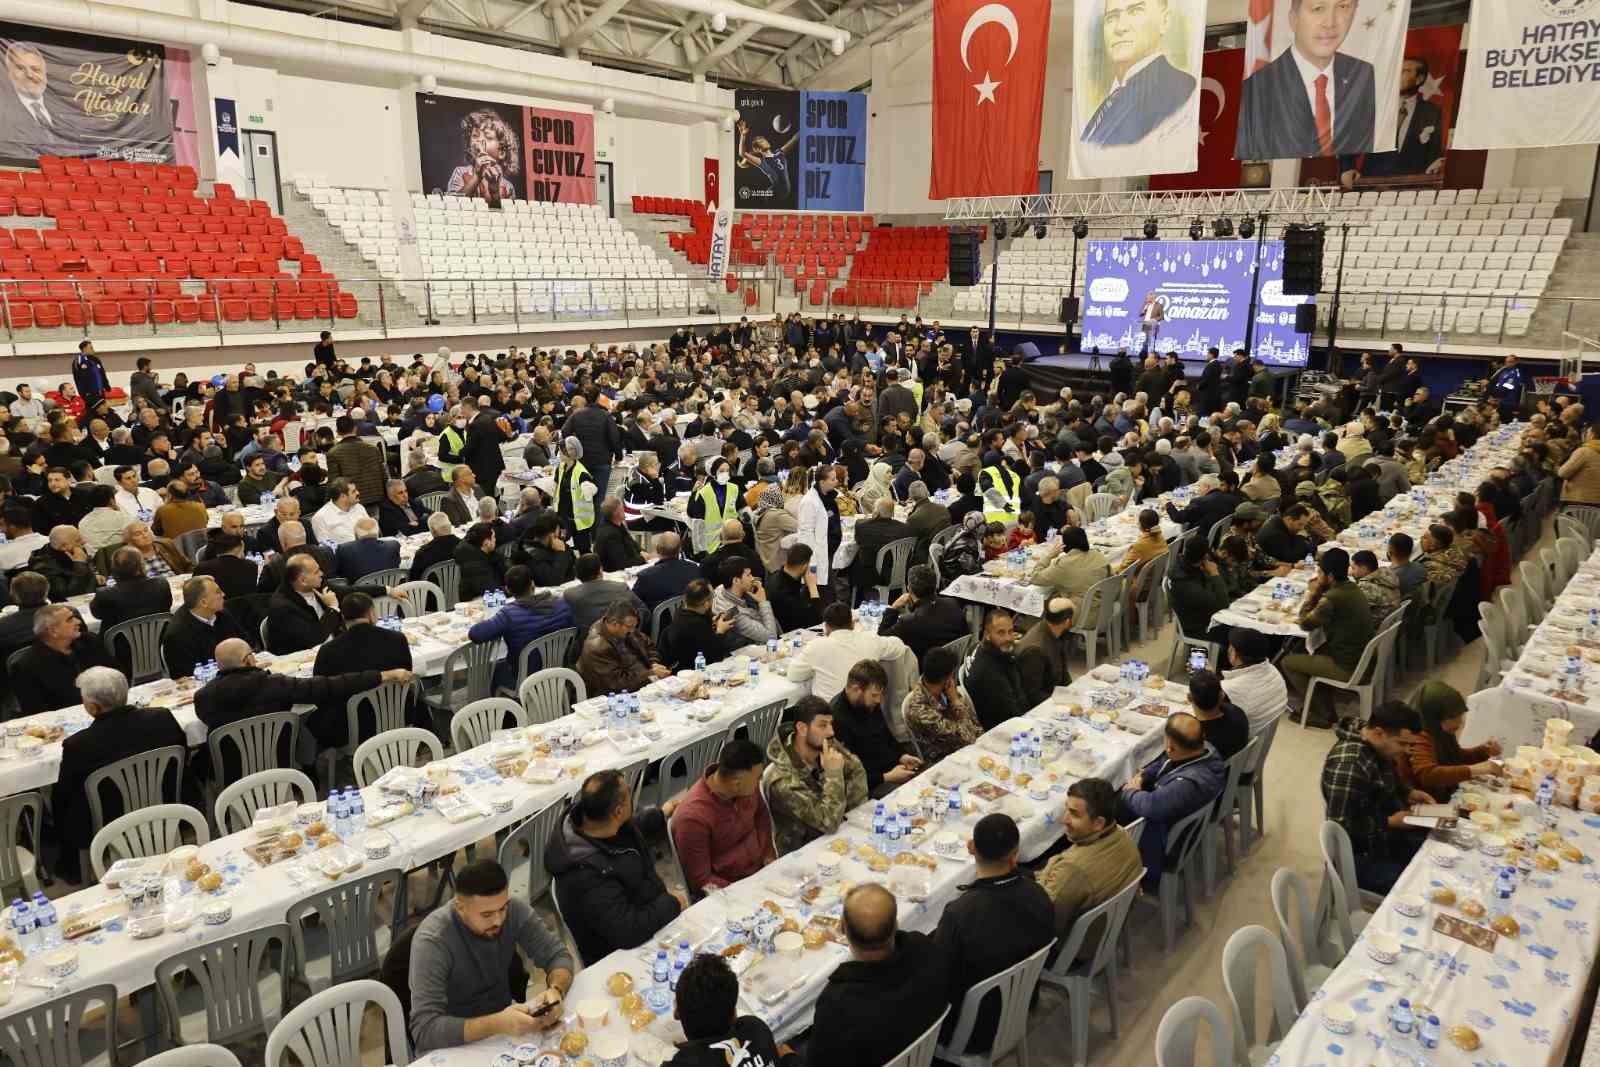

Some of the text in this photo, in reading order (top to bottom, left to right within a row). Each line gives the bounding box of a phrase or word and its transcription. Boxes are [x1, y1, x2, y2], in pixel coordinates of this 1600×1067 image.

[1522, 19, 1600, 45] HATAY
[1486, 40, 1600, 68] BÜYÜKŞE
[1492, 62, 1600, 88] BELEDİYE
[806, 99, 848, 129] SPOR
[531, 116, 575, 145] SPOR
[532, 148, 585, 178] CUYUZ
[806, 135, 856, 165] CUYUZ
[710, 233, 724, 283] HATAY
